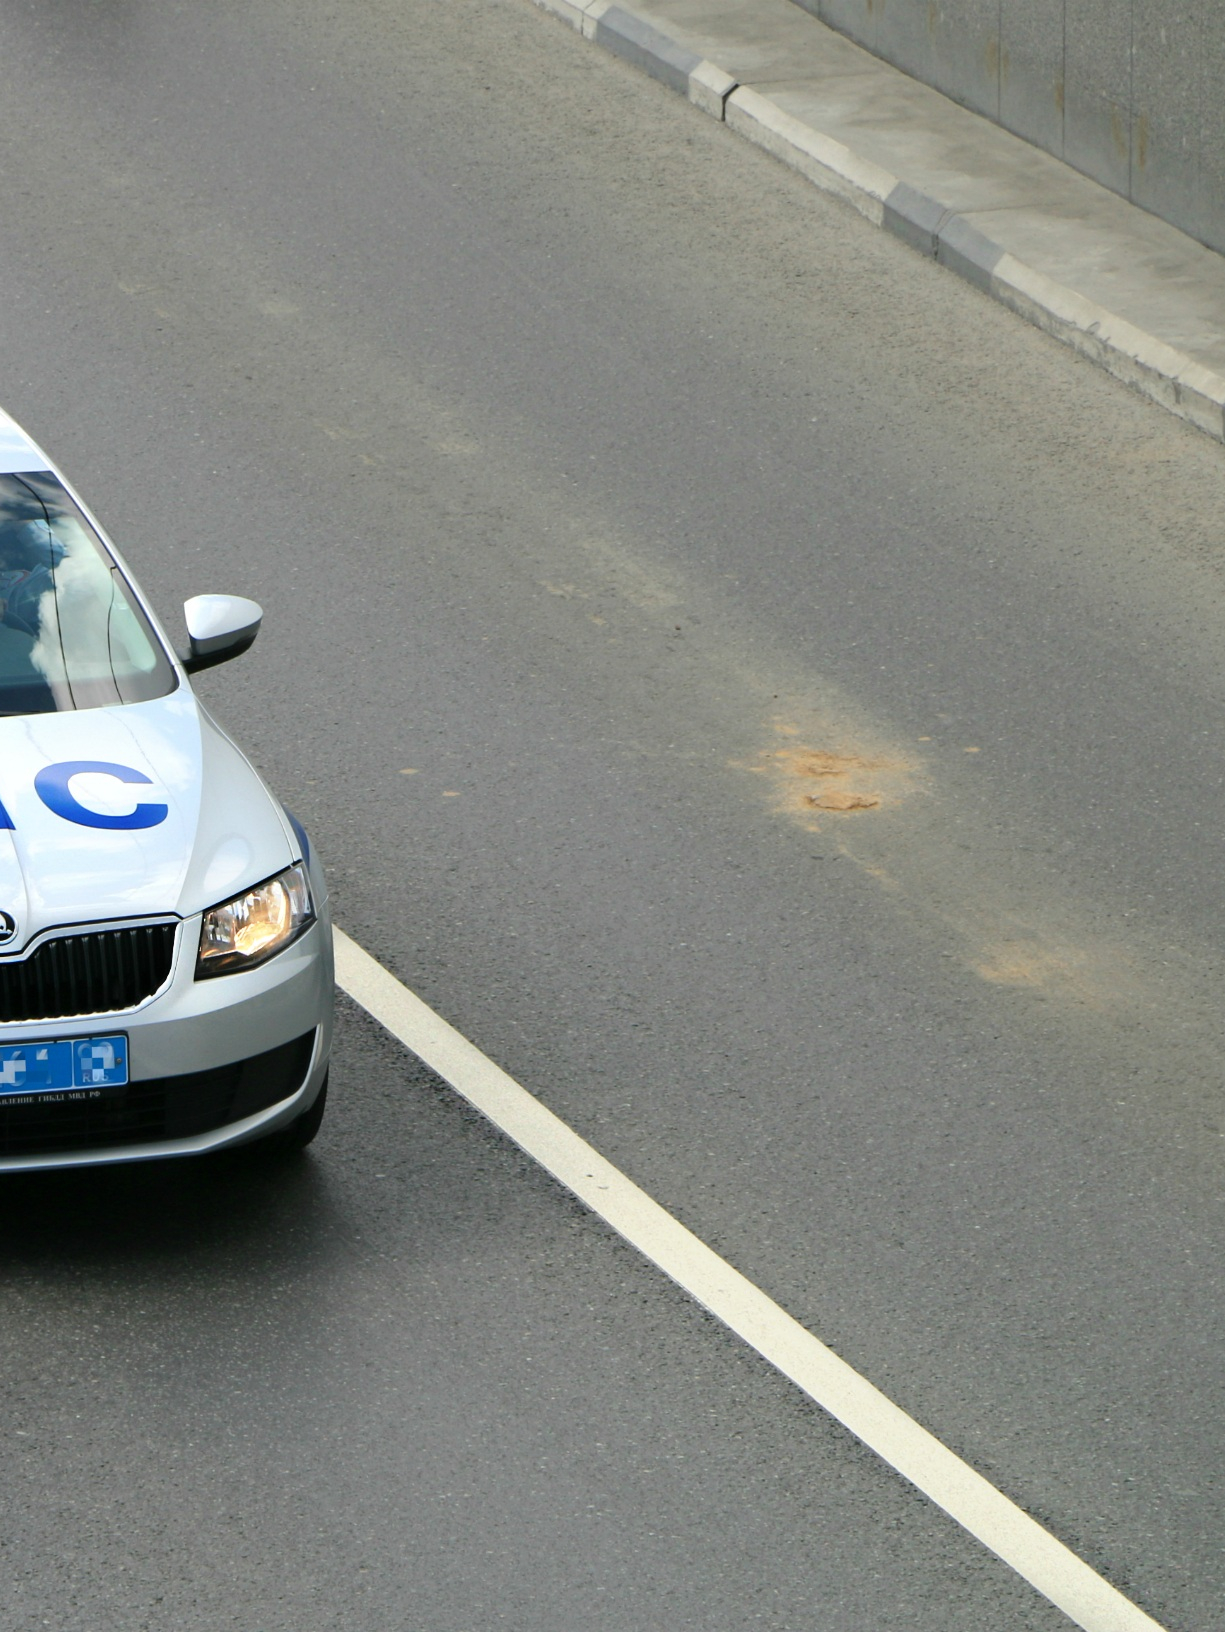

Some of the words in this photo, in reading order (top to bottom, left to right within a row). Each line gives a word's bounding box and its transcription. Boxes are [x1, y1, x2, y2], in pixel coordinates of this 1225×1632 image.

[38, 1092, 66, 1102] ГИБДД
[68, 1091, 86, 1100] МВД
[89, 1090, 101, 1098] РФ
